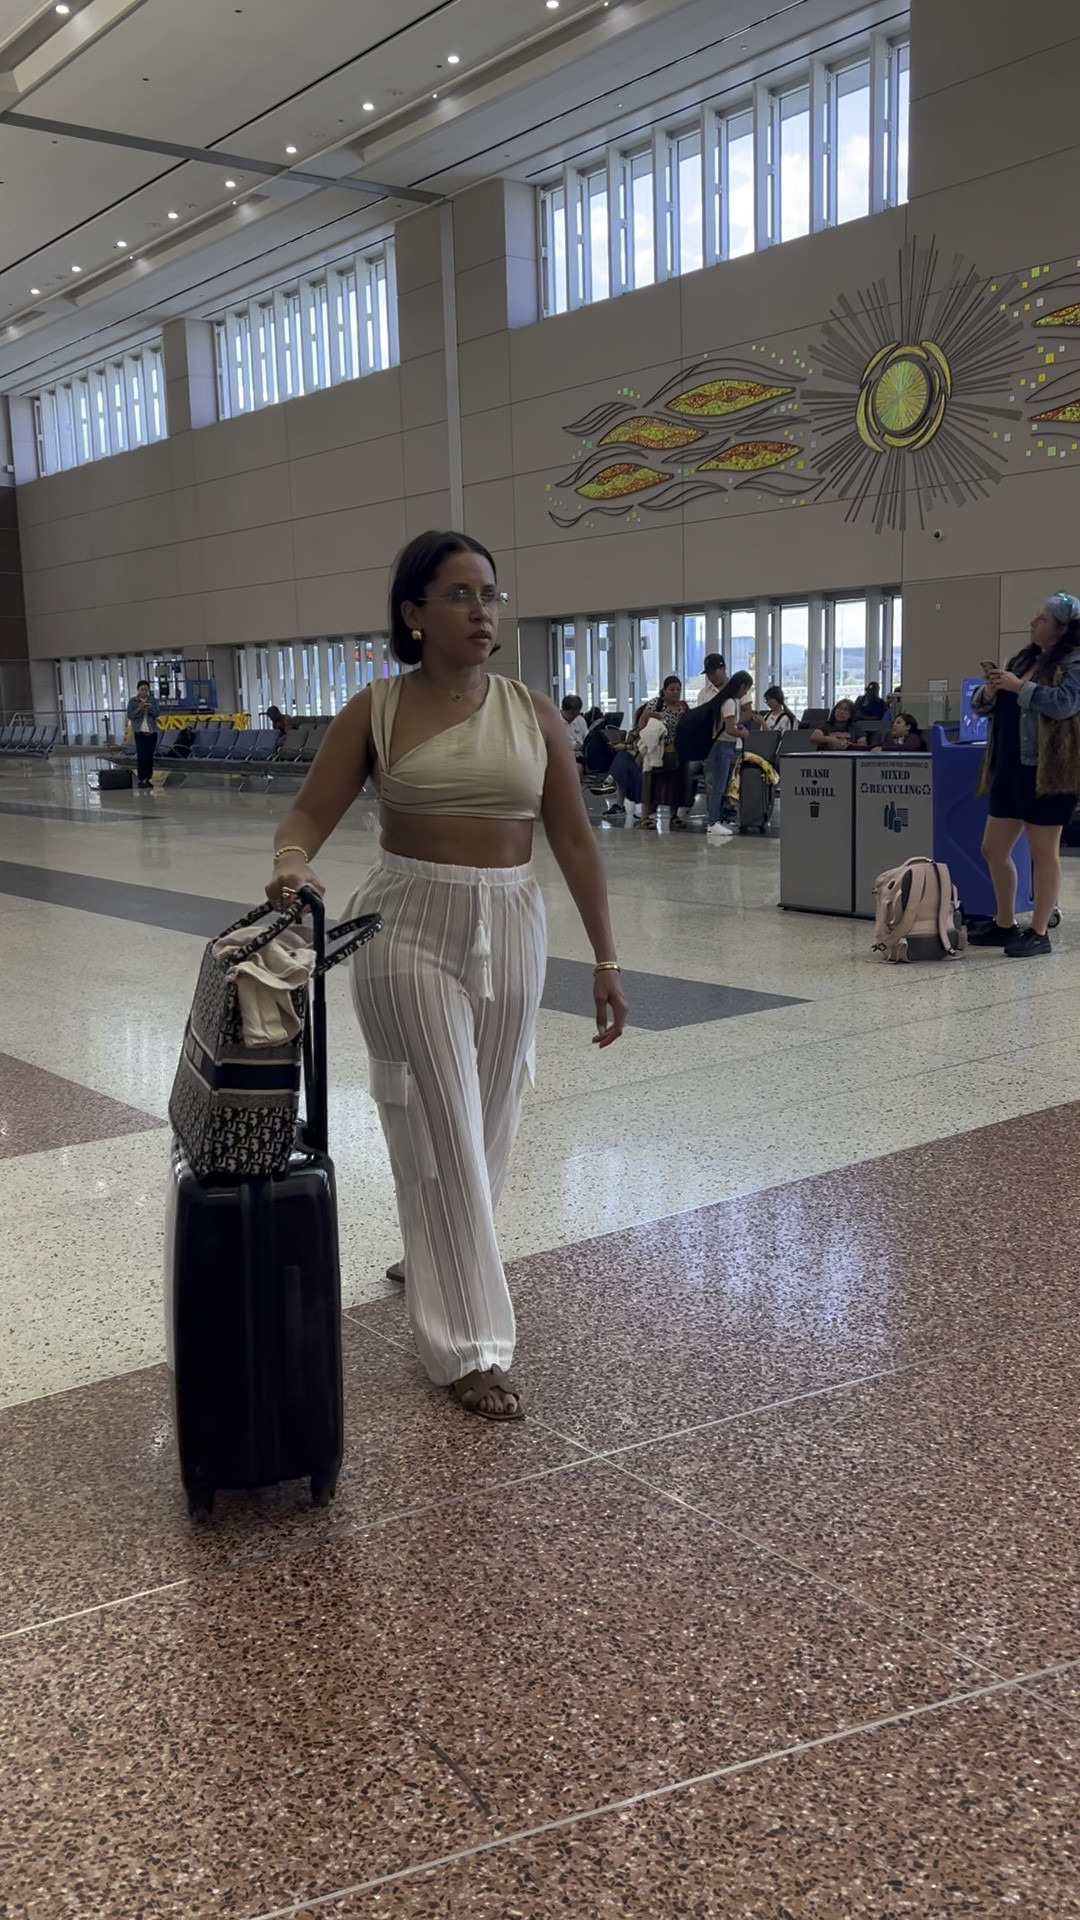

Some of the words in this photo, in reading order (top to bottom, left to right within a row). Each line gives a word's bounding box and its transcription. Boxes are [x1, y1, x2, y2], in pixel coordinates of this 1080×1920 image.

[801, 769, 829, 779] TRASH
[881, 770, 910, 780] MIXED
[794, 787, 836, 797] LANDFILL
[870, 784, 922, 795] RECYCLING
